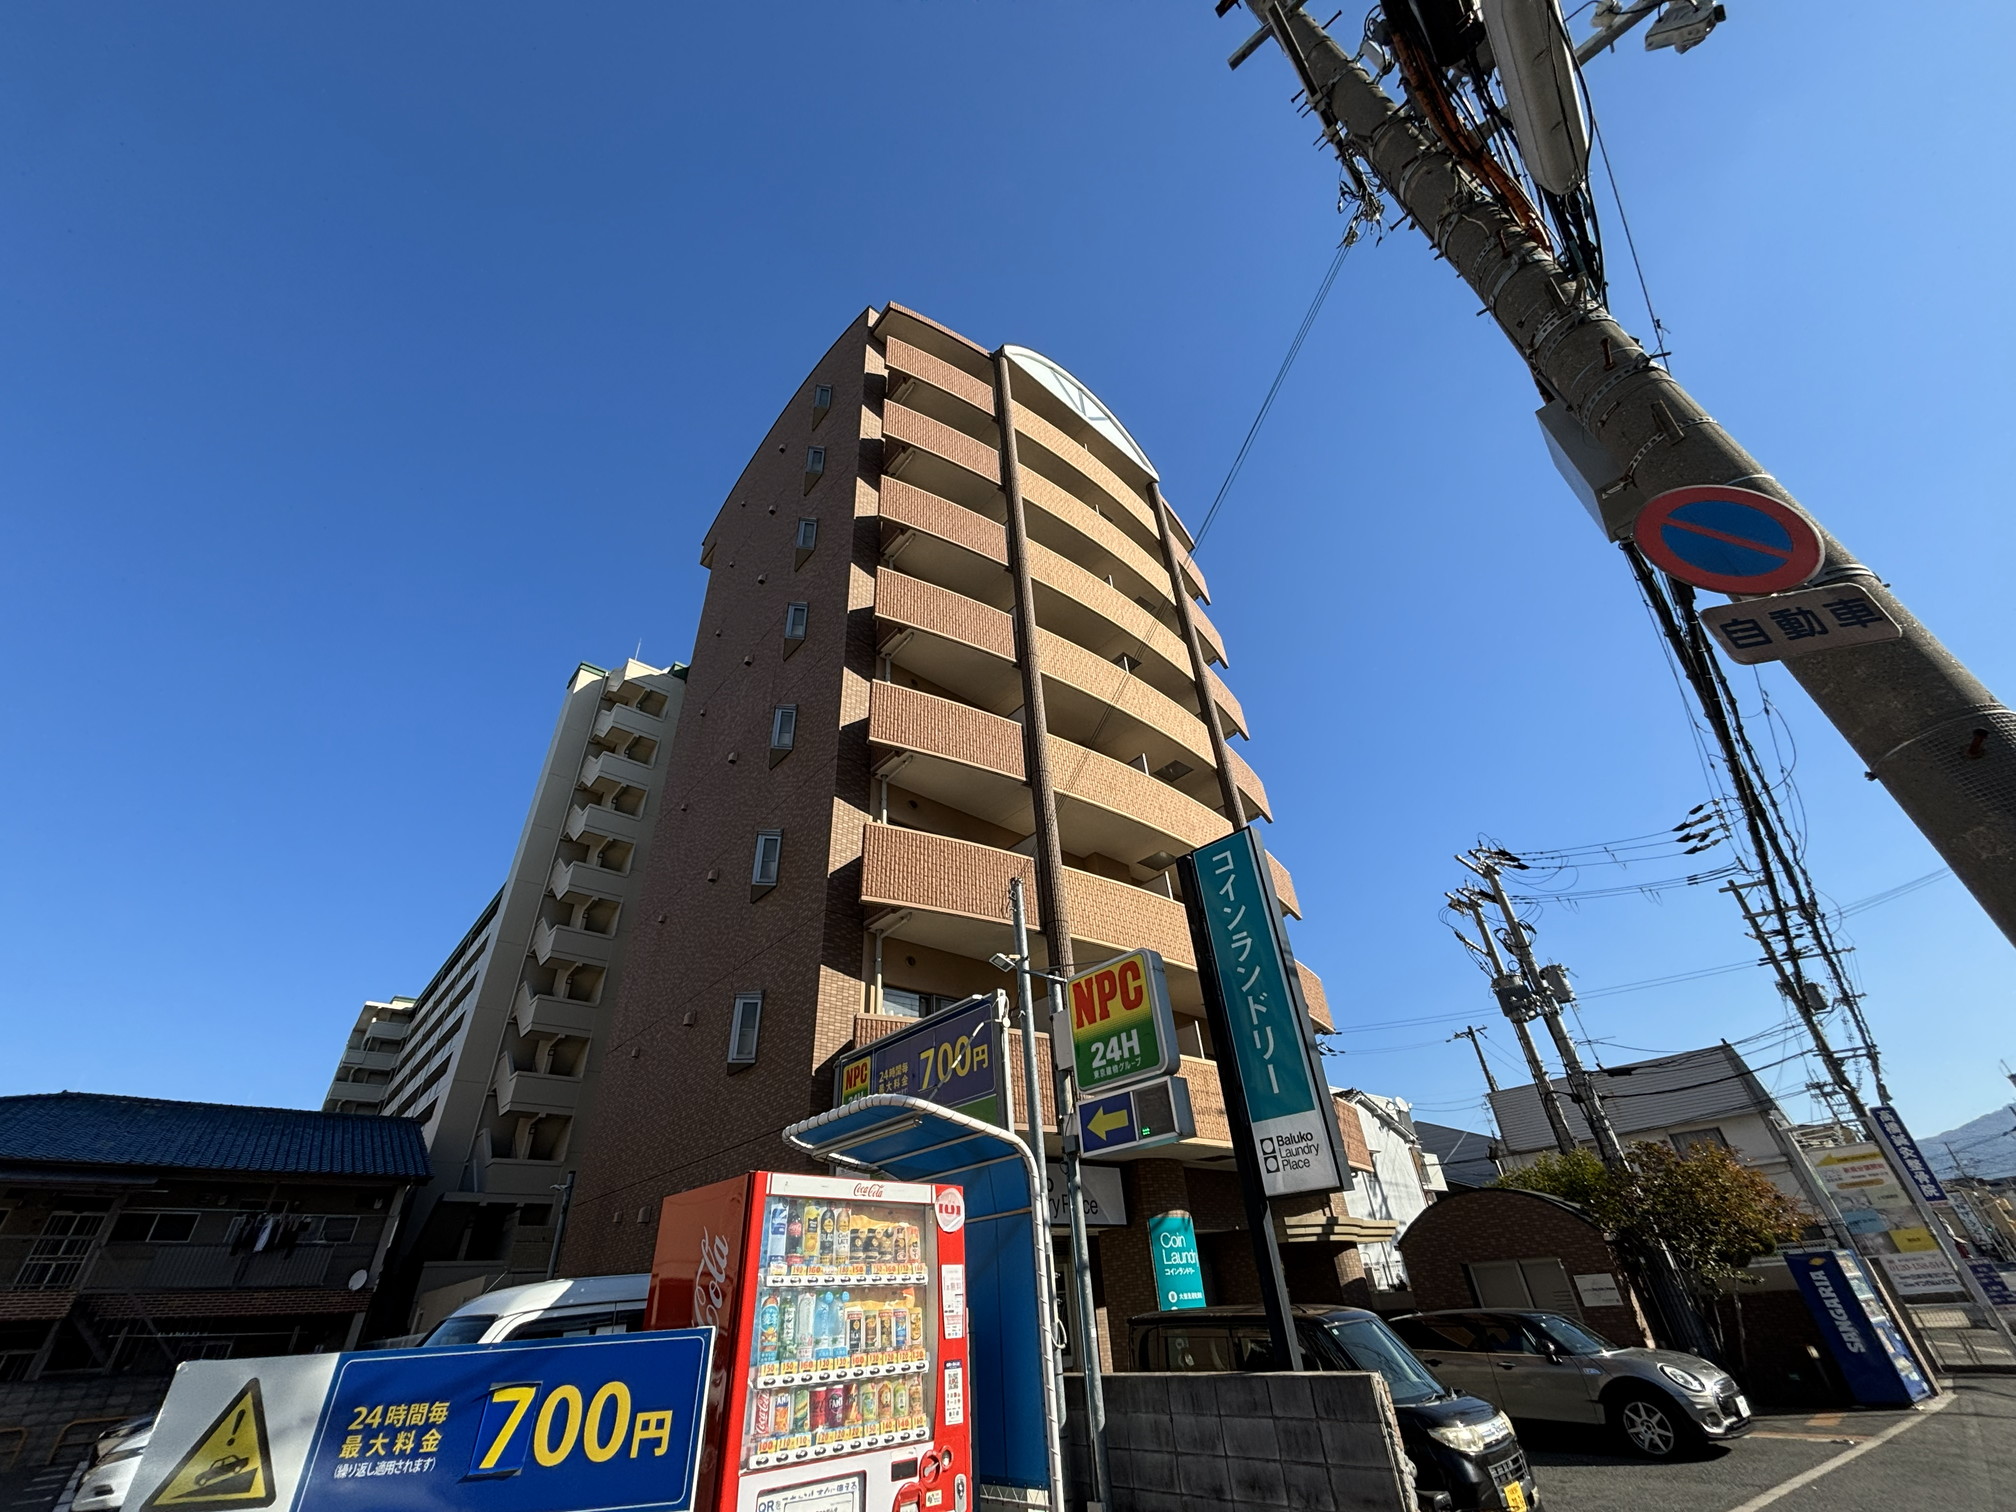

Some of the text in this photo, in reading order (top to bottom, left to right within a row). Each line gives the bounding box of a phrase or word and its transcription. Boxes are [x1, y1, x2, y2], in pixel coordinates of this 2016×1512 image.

[1719, 597, 1884, 649] 自動車
[1211, 850, 1280, 1095] コインランドリー
[1072, 961, 1143, 1030] NPC
[919, 1034, 989, 1091] 700円
[1090, 1028, 1140, 1069] 24H
[846, 1062, 868, 1091] NPC
[1276, 1131, 1314, 1151] Baluko
[1278, 1142, 1320, 1160] Laundry
[1281, 1157, 1311, 1171] Place
[1160, 1231, 1187, 1249] Coin
[1809, 1270, 1866, 1353] SANGARIA
[347, 1401, 451, 1431] 24時間毎
[479, 1380, 673, 1470] 700円
[338, 1428, 443, 1459] 最大料金
